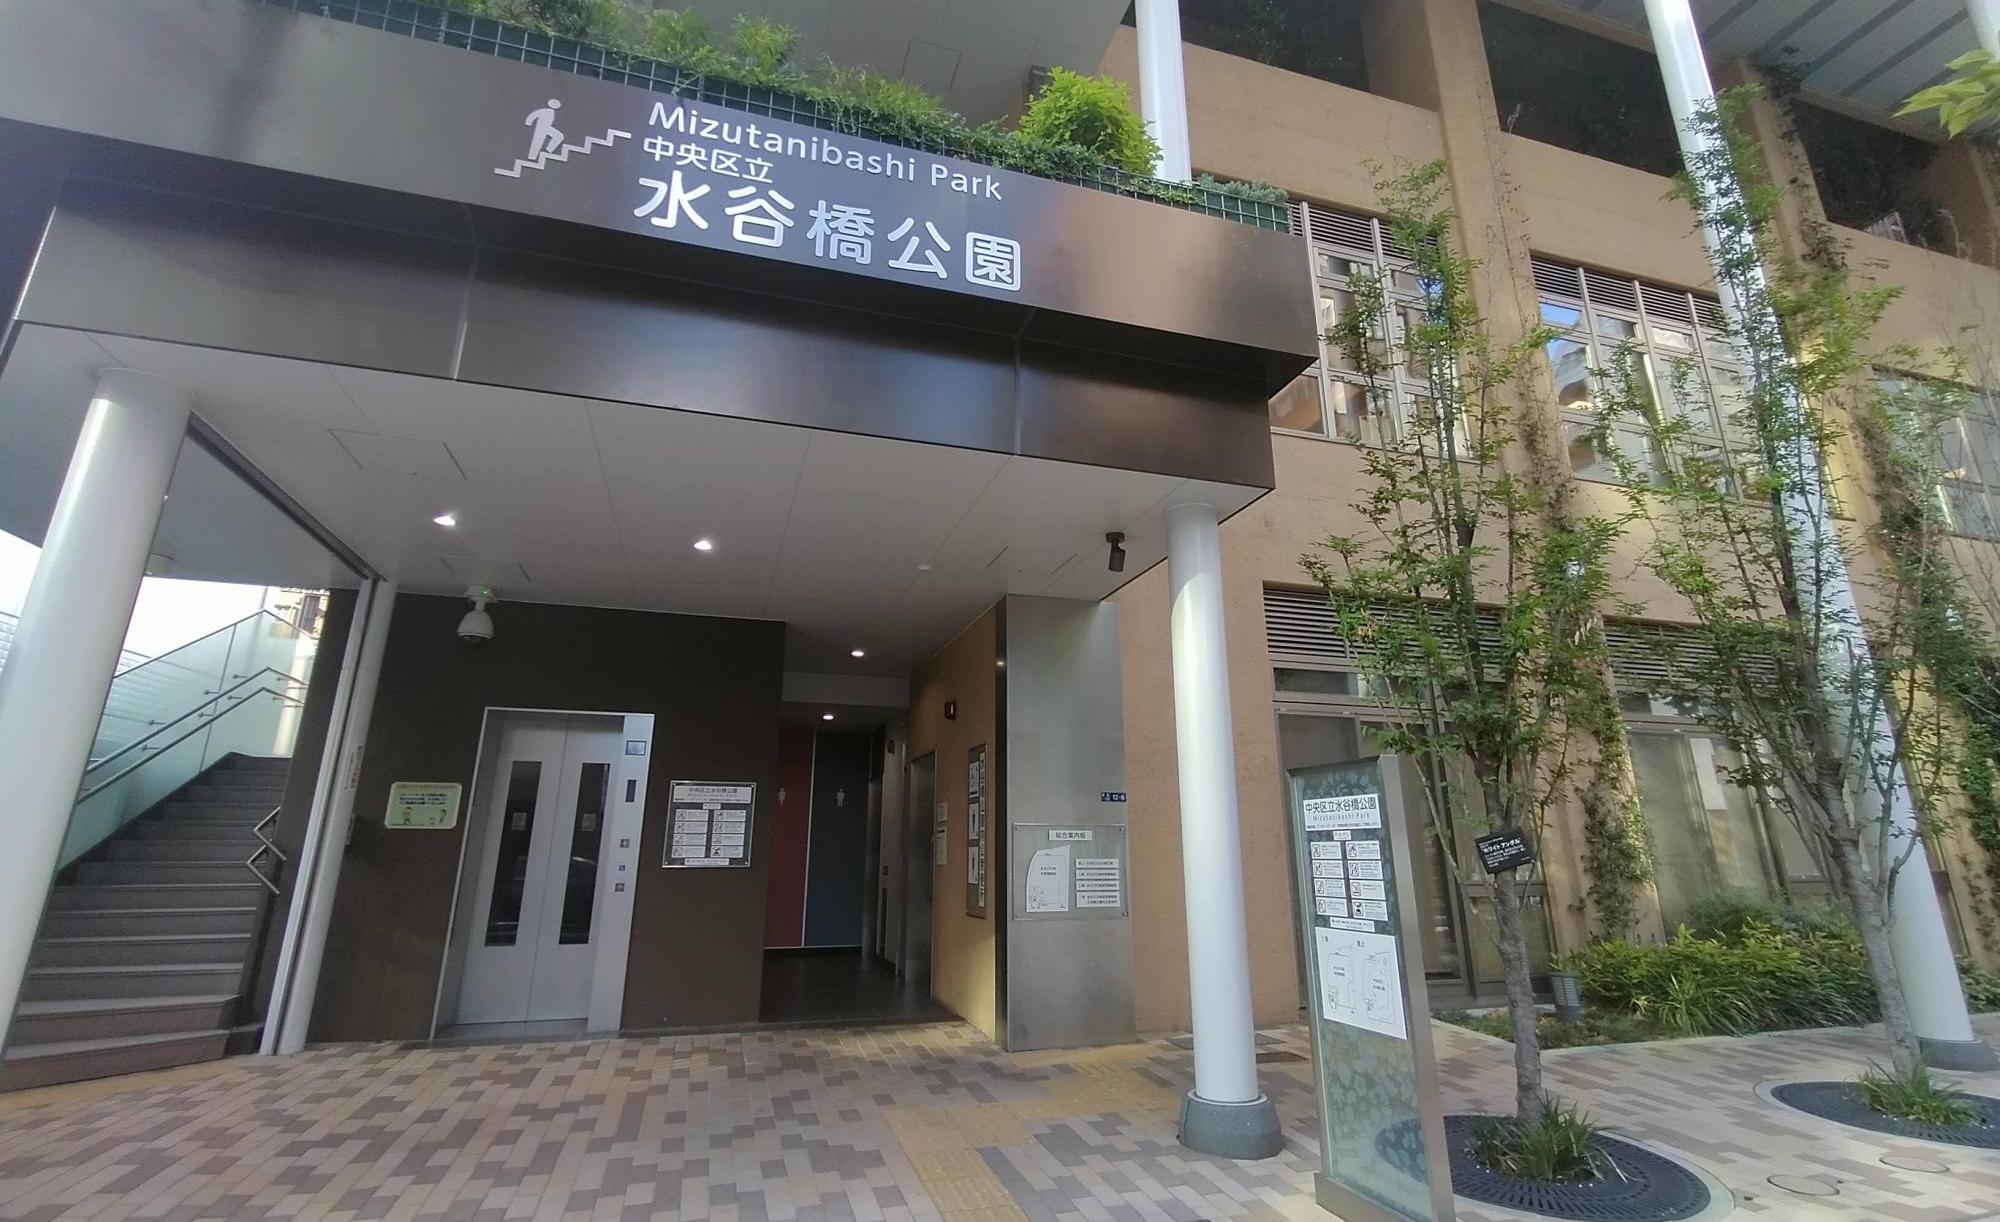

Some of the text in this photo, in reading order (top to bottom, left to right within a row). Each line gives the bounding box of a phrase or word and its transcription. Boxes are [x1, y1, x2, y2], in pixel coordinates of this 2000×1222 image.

[643, 135, 773, 184] 中央区立
[648, 101, 1002, 201] Mizutanibashi Park
[633, 169, 1021, 291] 水谷橋公園
[1305, 797, 1377, 814] 中央区立水谷橋公園
